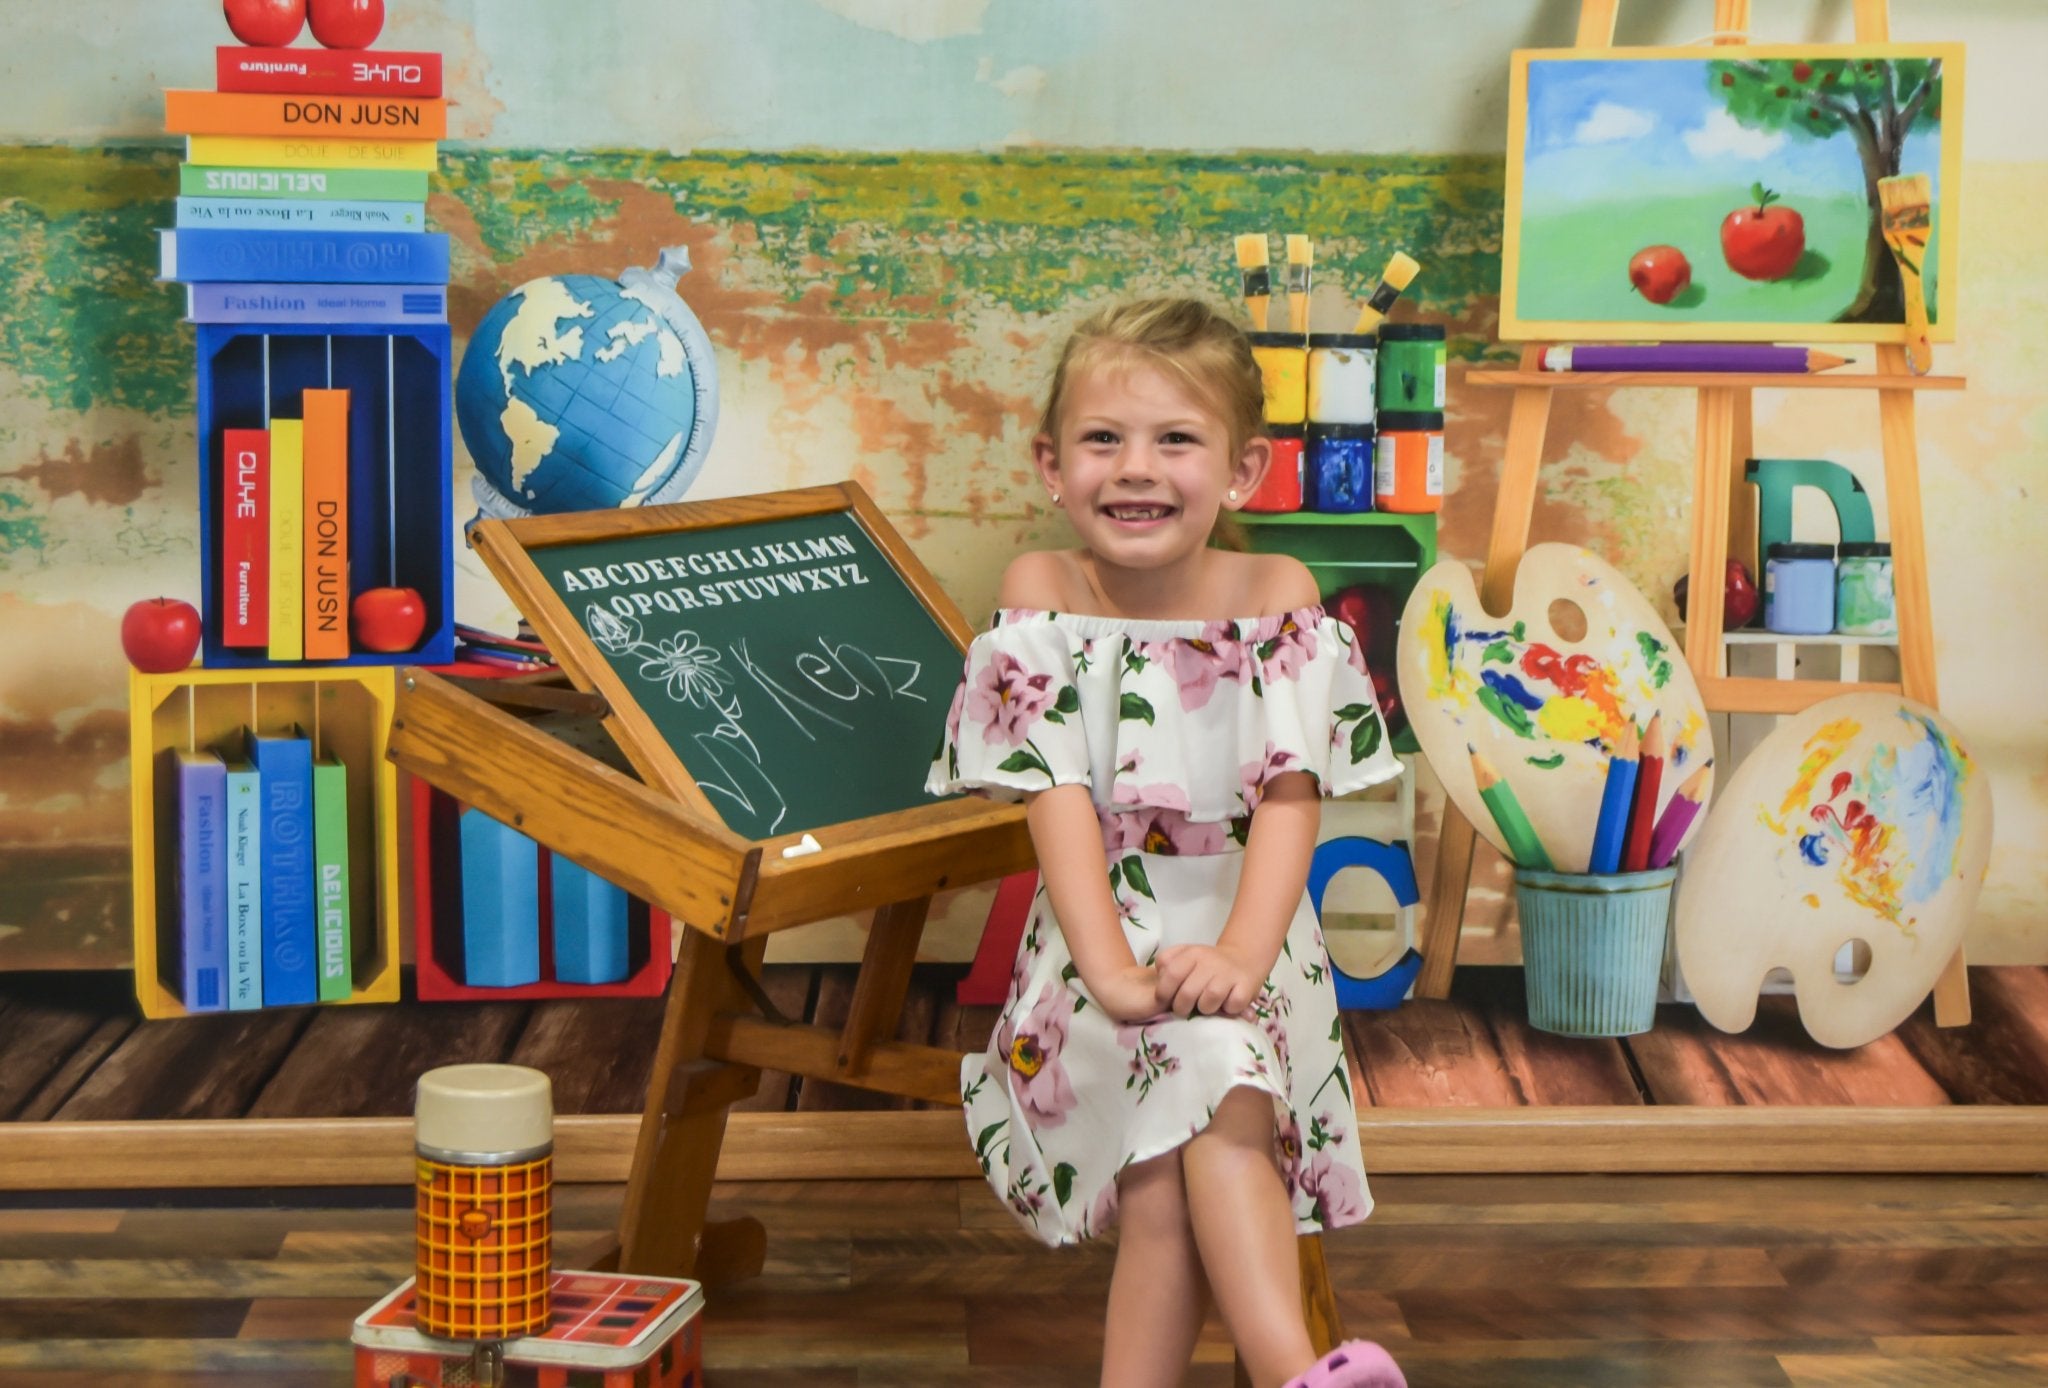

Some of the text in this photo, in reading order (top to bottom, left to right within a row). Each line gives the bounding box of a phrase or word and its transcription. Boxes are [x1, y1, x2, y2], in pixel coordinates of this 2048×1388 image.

[239, 61, 307, 75] Furniture
[283, 102, 420, 126] DON JUSN
[205, 171, 327, 192] DELICIOUS
[189, 206, 313, 221] La Boxe ou la Vie
[224, 296, 305, 311] Fashion
[317, 501, 338, 632] DON JUSN
[562, 535, 857, 592] ABCDEFGHIJKLMN
[239, 561, 251, 625] Furniture
[610, 563, 869, 618] OPQRSTUVWXYZ
[198, 795, 213, 874] Fashion
[270, 781, 307, 972] ROTHKO
[238, 882, 250, 901] La
[238, 904, 250, 937] Boxe
[322, 864, 344, 979] DELICIOUS
[238, 941, 246, 959] ou
[238, 978, 250, 1000] Vie
